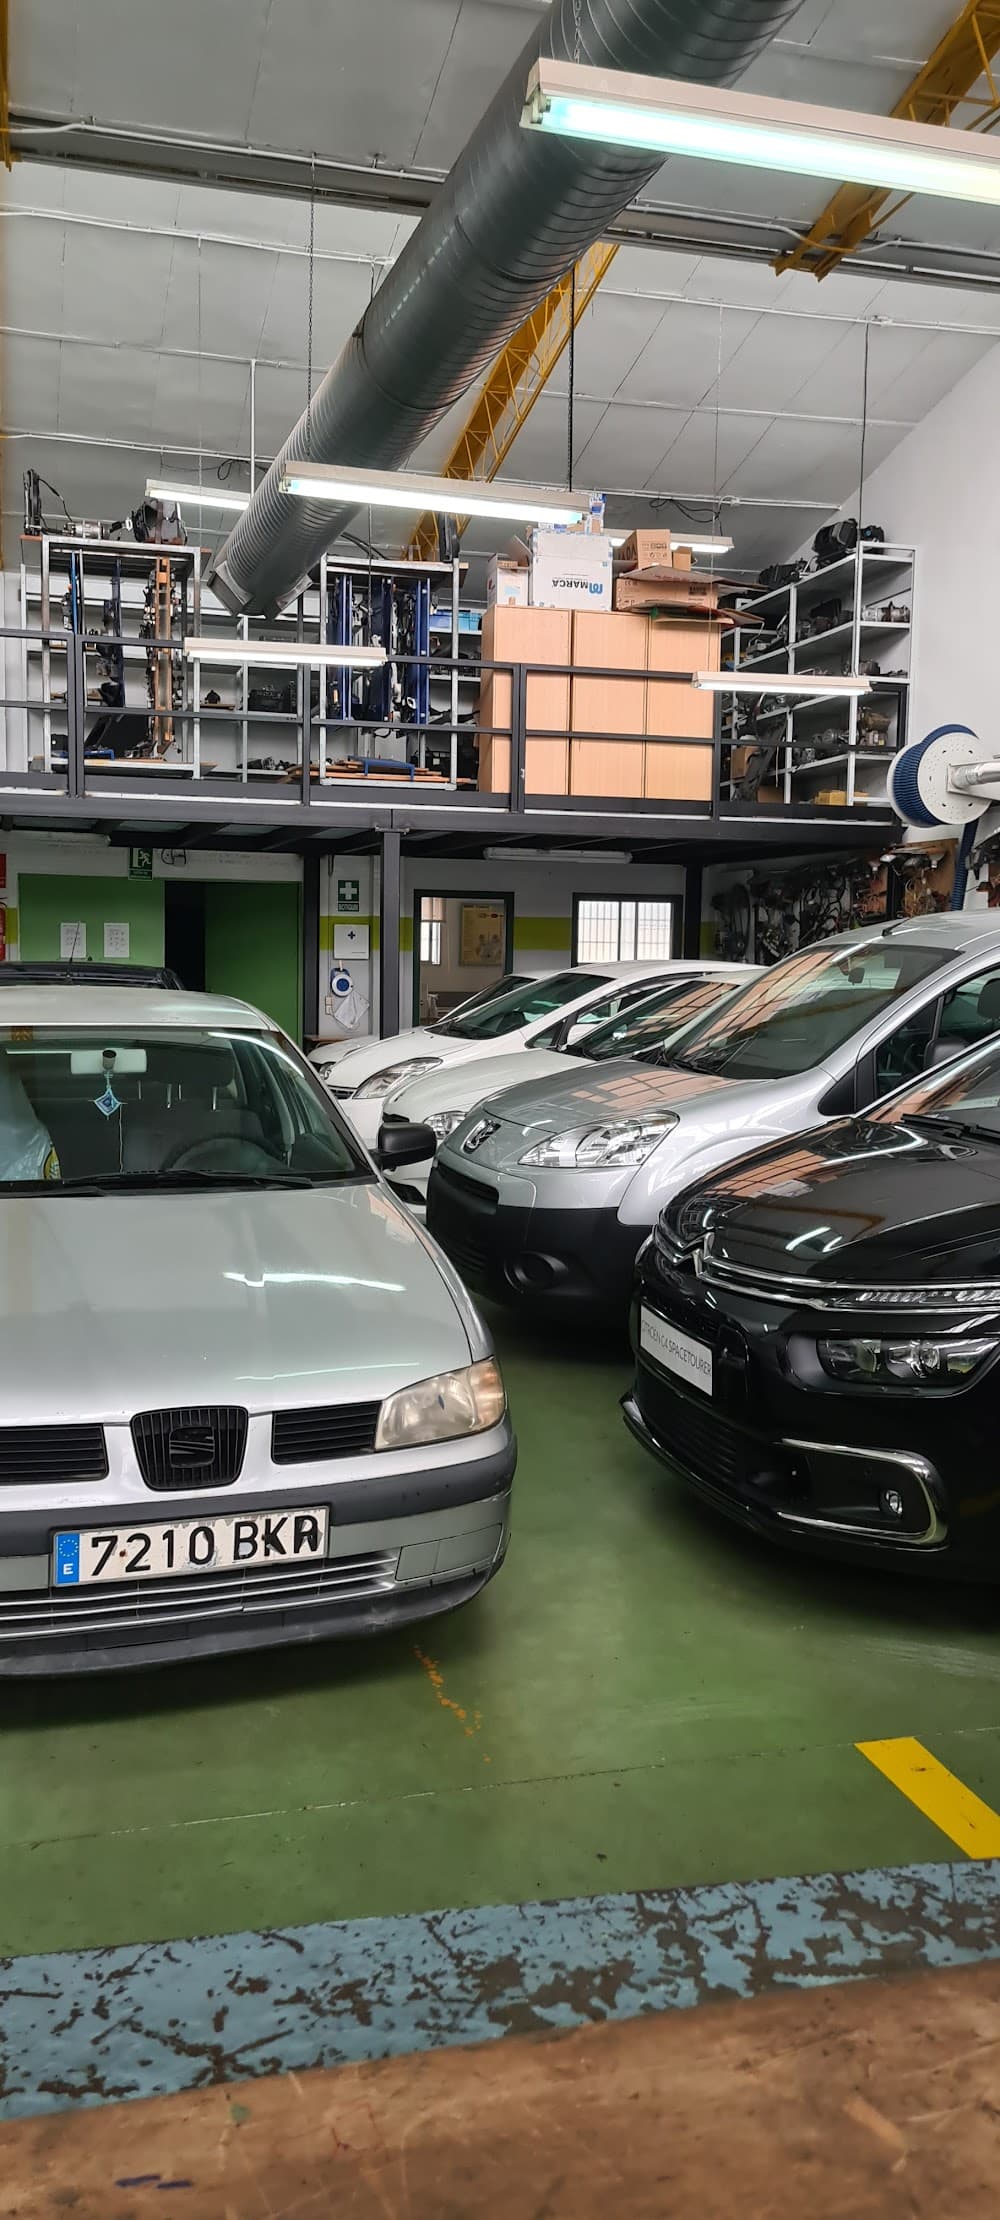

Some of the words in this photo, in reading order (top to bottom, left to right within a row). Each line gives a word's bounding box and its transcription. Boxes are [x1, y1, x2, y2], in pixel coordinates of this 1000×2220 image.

[552, 579, 589, 589] MARCA
[668, 1340, 711, 1376] SPACETOURER
[91, 1526, 215, 1576] 7210
[63, 1563, 74, 1575] E
